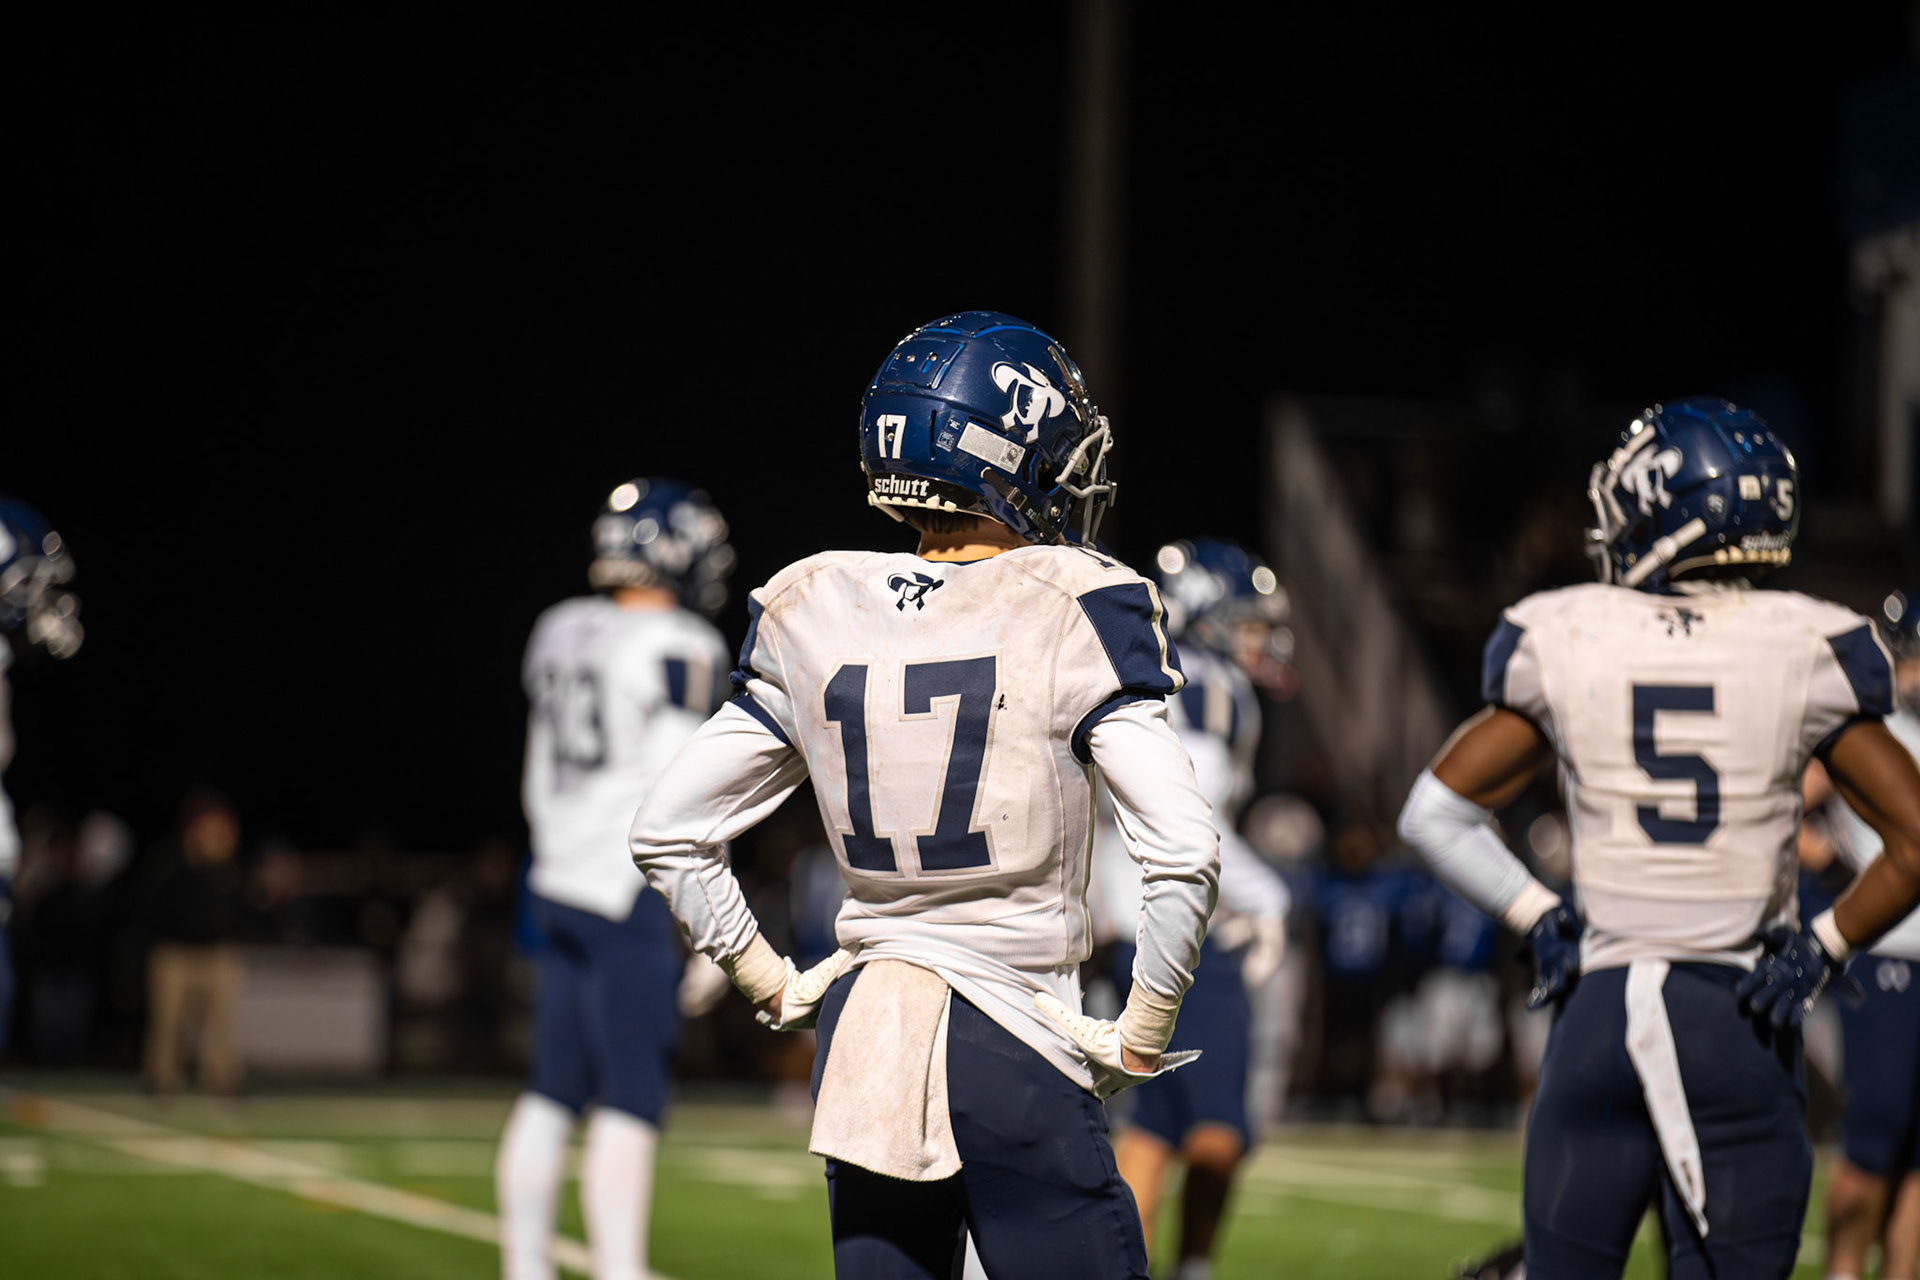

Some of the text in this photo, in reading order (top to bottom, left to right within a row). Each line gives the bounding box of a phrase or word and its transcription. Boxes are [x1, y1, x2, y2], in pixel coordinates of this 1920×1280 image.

[877, 415, 906, 459] 17
[875, 474, 930, 497] schutt
[1776, 478, 1794, 521] 5
[823, 655, 998, 875] 17
[1631, 683, 1720, 844] 5
